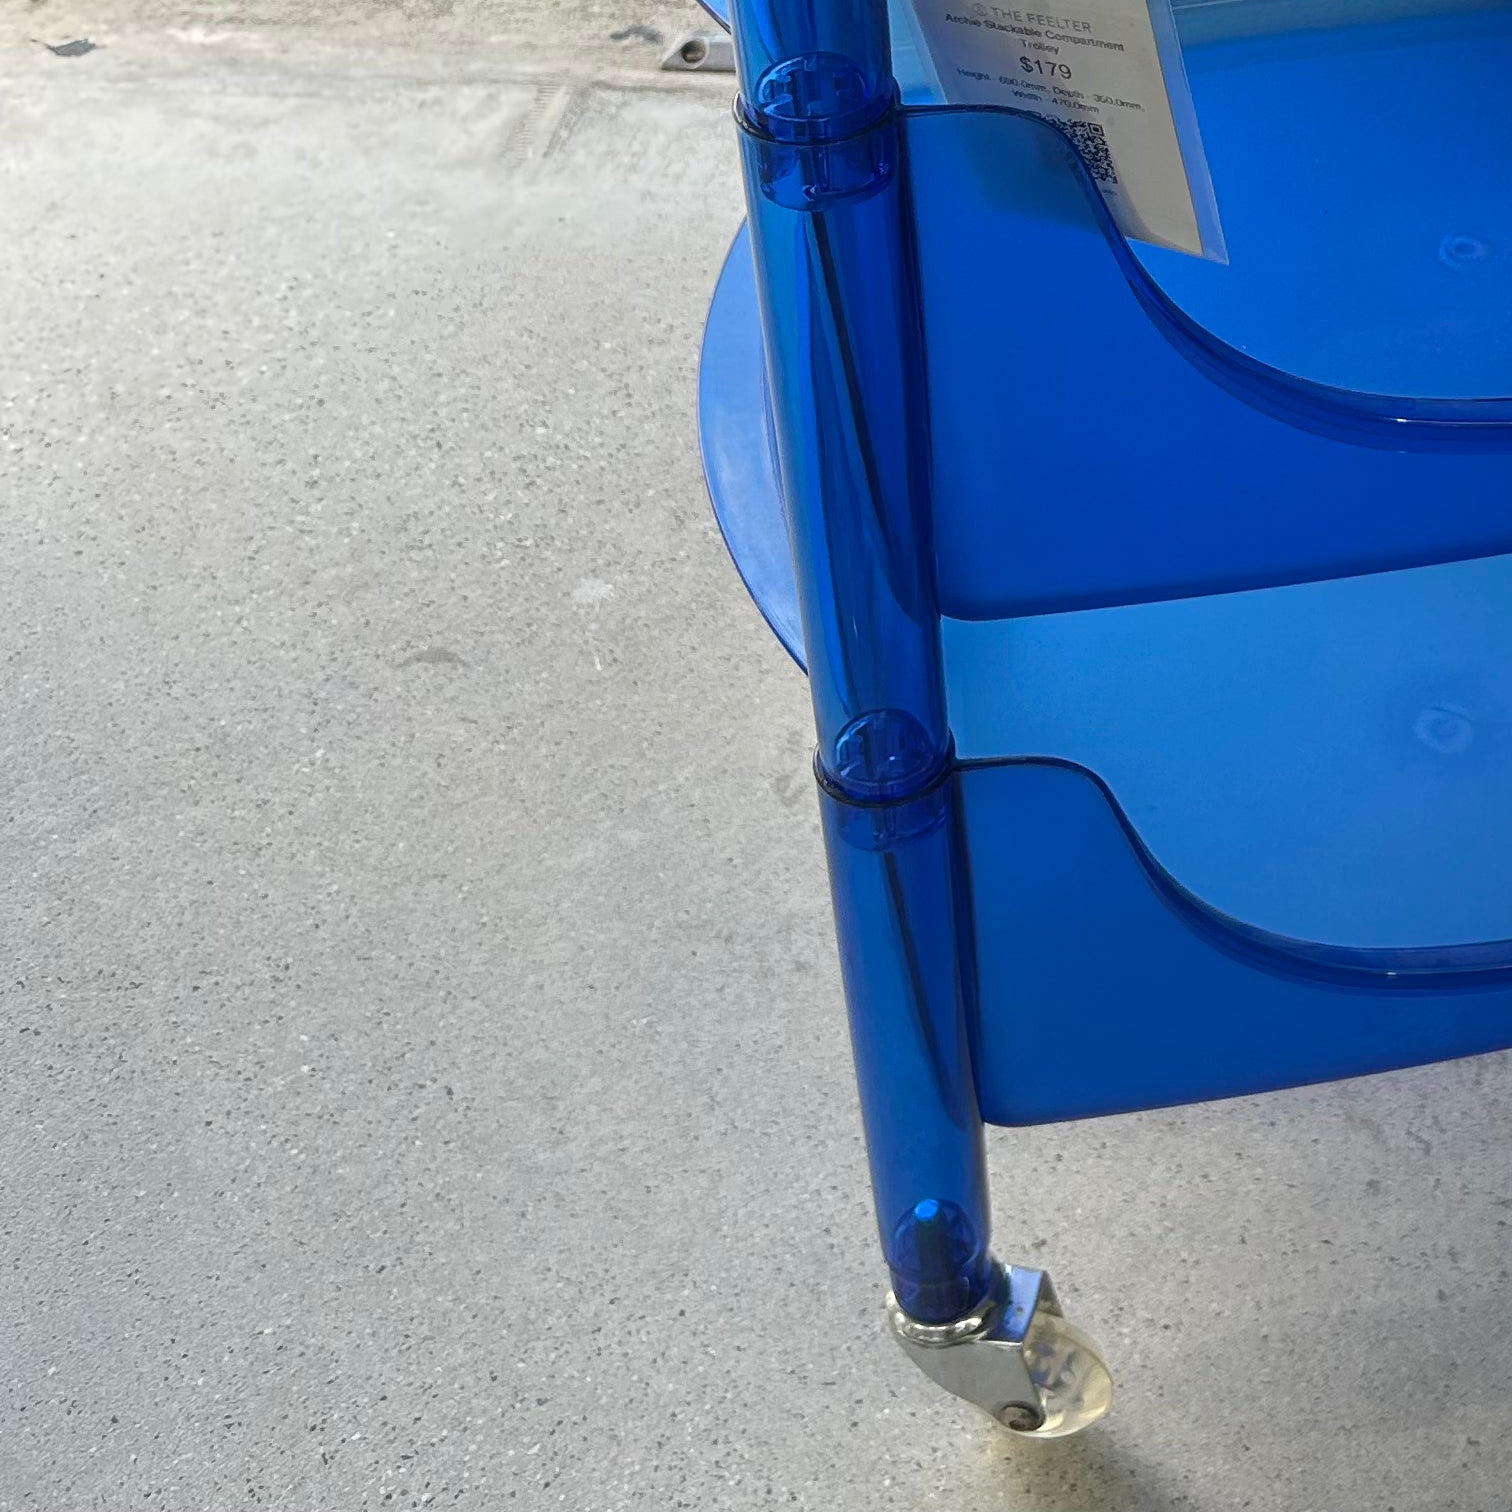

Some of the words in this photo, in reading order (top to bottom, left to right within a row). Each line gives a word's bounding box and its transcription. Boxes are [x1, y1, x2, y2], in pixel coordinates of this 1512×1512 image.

[990, 7, 1023, 23] THE
[1026, 12, 1092, 34] FEELTER
[983, 19, 1042, 37] Stackable
[1045, 30, 1125, 52] Compartment
[1020, 38, 1060, 55] Trolley
[1020, 55, 1072, 80] $179
[1052, 86, 1085, 100] Depth
